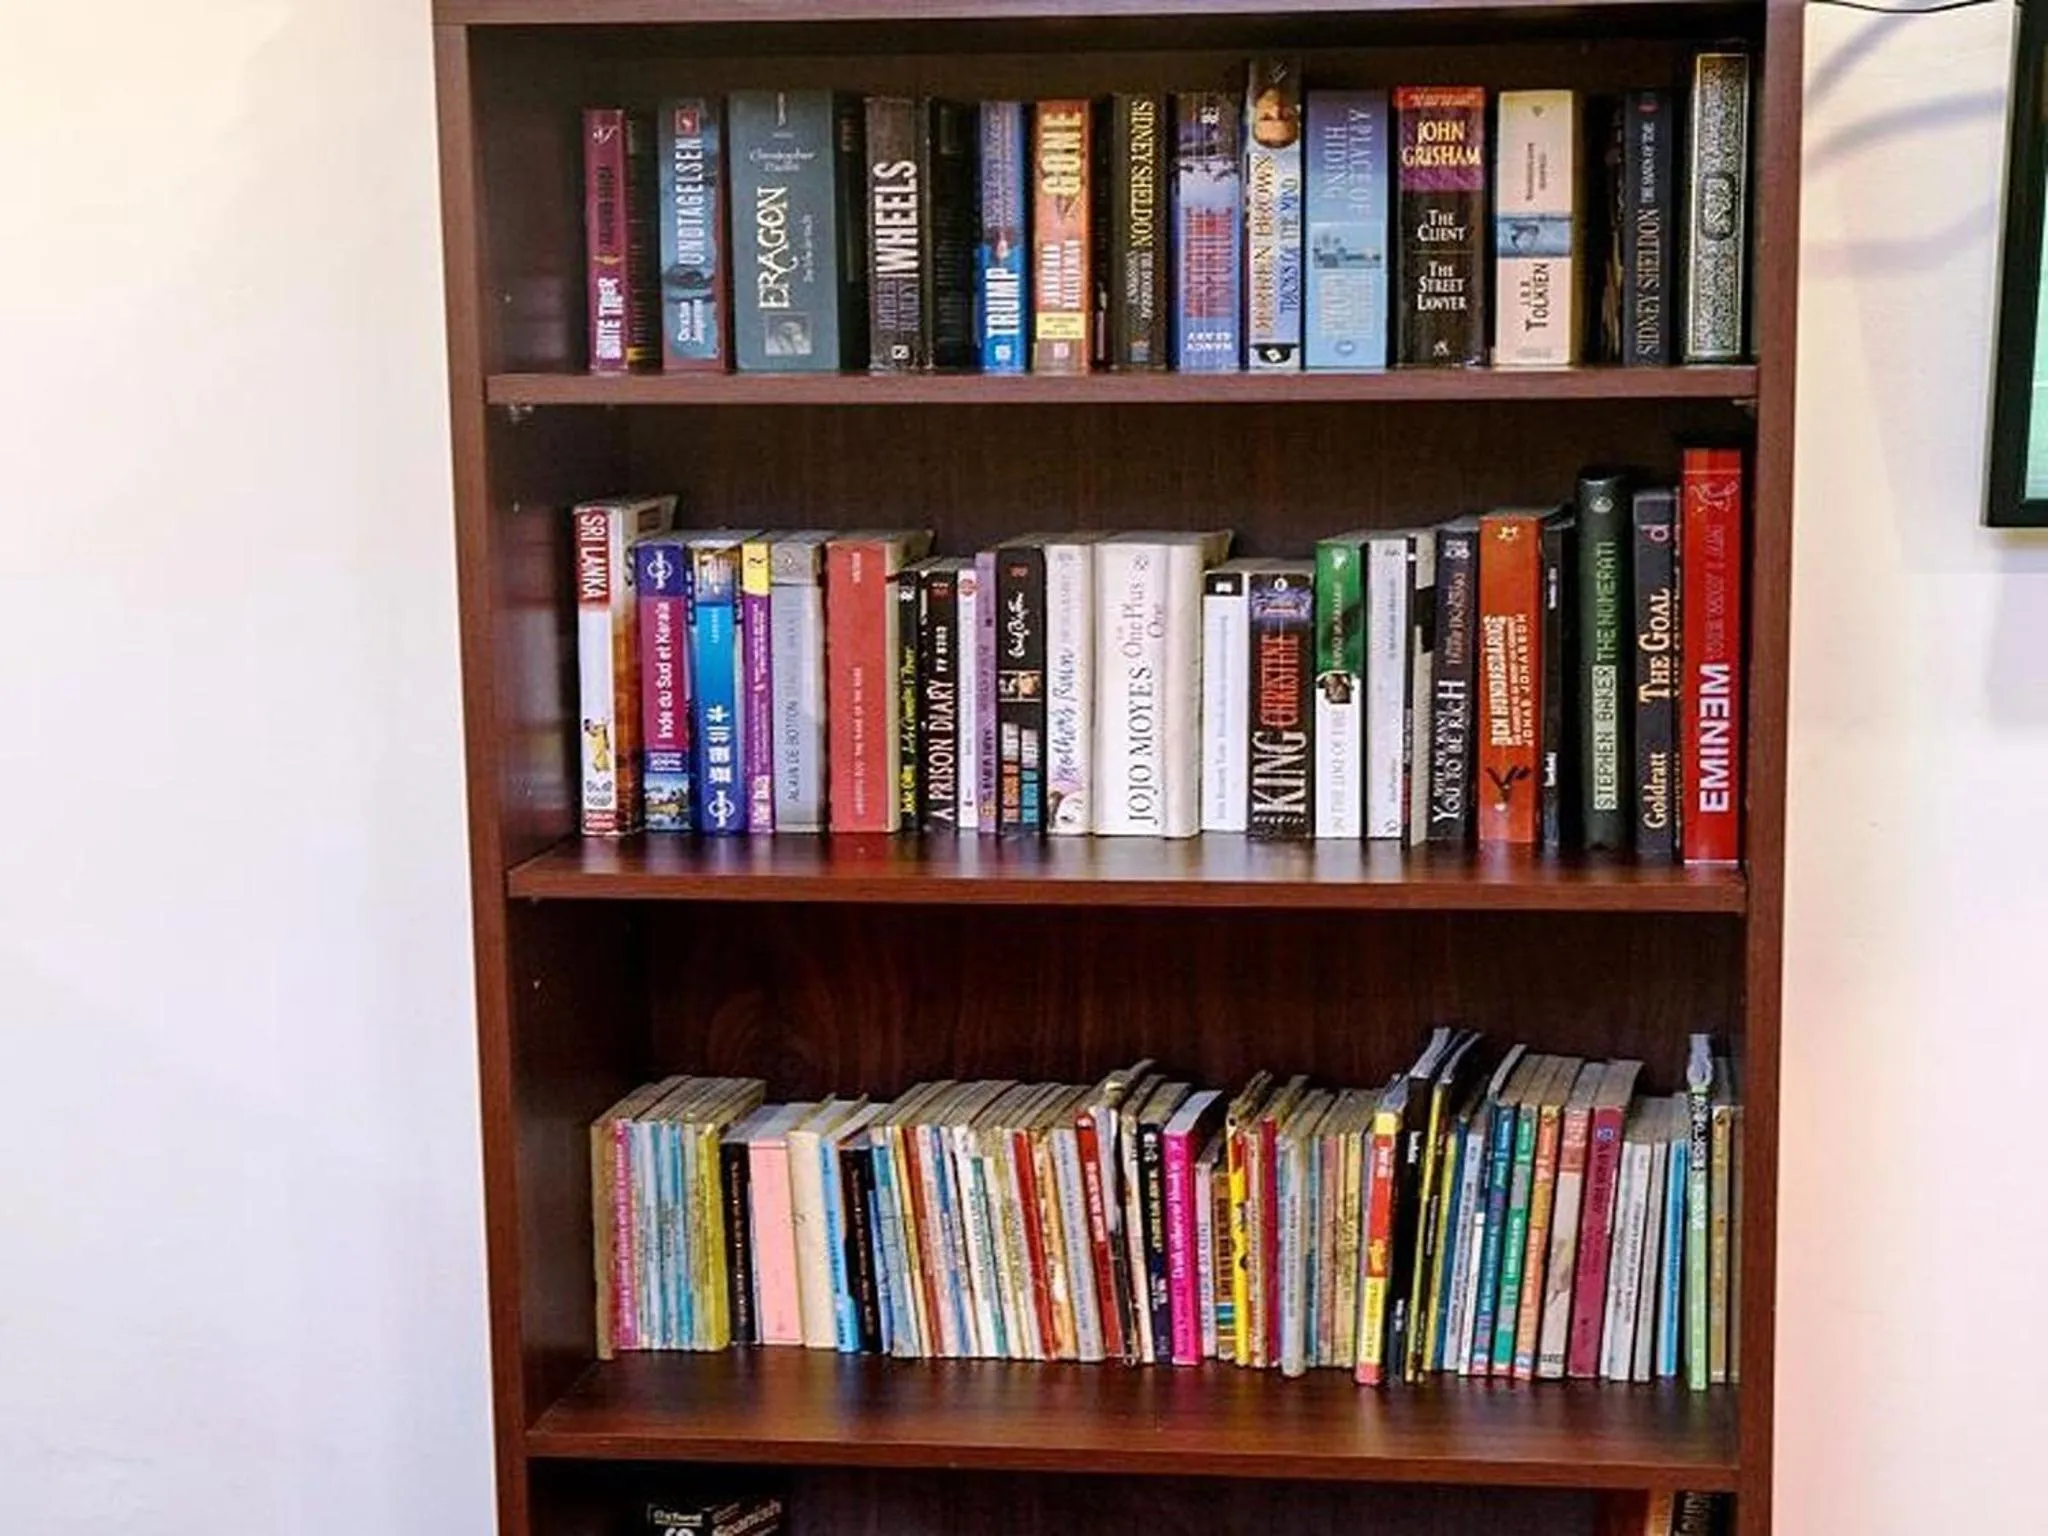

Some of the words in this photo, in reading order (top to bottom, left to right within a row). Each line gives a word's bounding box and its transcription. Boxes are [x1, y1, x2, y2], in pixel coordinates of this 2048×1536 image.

[1041, 111, 1082, 196] GONE
[1130, 101, 1154, 165] SIDNEY
[1350, 124, 1372, 184] PLACE
[1402, 145, 1481, 167] GRISHAM
[1417, 120, 1465, 145] JOHN
[1324, 127, 1348, 199] HIDING
[873, 160, 919, 271] WHEELS
[1130, 166, 1154, 247] SHELDON
[1251, 155, 1274, 237] BROWN
[1427, 209, 1455, 227] THE
[757, 185, 798, 309] ERAGON
[1417, 223, 1466, 242] CLIENT
[1636, 207, 1661, 291] SHELDON
[1418, 275, 1464, 294] STREET
[1427, 260, 1454, 278] THE
[984, 267, 1021, 339] TRUMP
[1417, 293, 1467, 311] LAWYER
[1525, 263, 1549, 332] TOLKIEN
[1636, 293, 1661, 355] SIDNEY
[579, 513, 607, 542] SRI
[580, 546, 608, 599] LANKA
[1596, 540, 1617, 627] NUMERATI
[1120, 582, 1143, 620] Plus
[1146, 603, 1165, 639] One
[1122, 623, 1146, 659] One
[1514, 613, 1531, 693] JONASSON
[1596, 629, 1616, 662] THE
[658, 664, 673, 689] Sud
[1260, 633, 1299, 726] CHRISTINE
[1593, 665, 1616, 721] BAKER
[657, 710, 674, 739] Inde
[927, 679, 954, 732] DIARY
[1129, 666, 1154, 758] MOYES
[1438, 679, 1468, 729] RICH
[1521, 698, 1534, 746] JONAS
[928, 738, 954, 801] PRISON
[1447, 760, 1464, 780] TO
[1448, 734, 1465, 754] BE
[1594, 729, 1616, 809] STEPHEN
[1129, 763, 1158, 827] JOJO
[1251, 730, 1307, 814] KING
[1643, 752, 1669, 828] Goldratt
[931, 808, 955, 821] A
[1433, 786, 1463, 822] YOU
